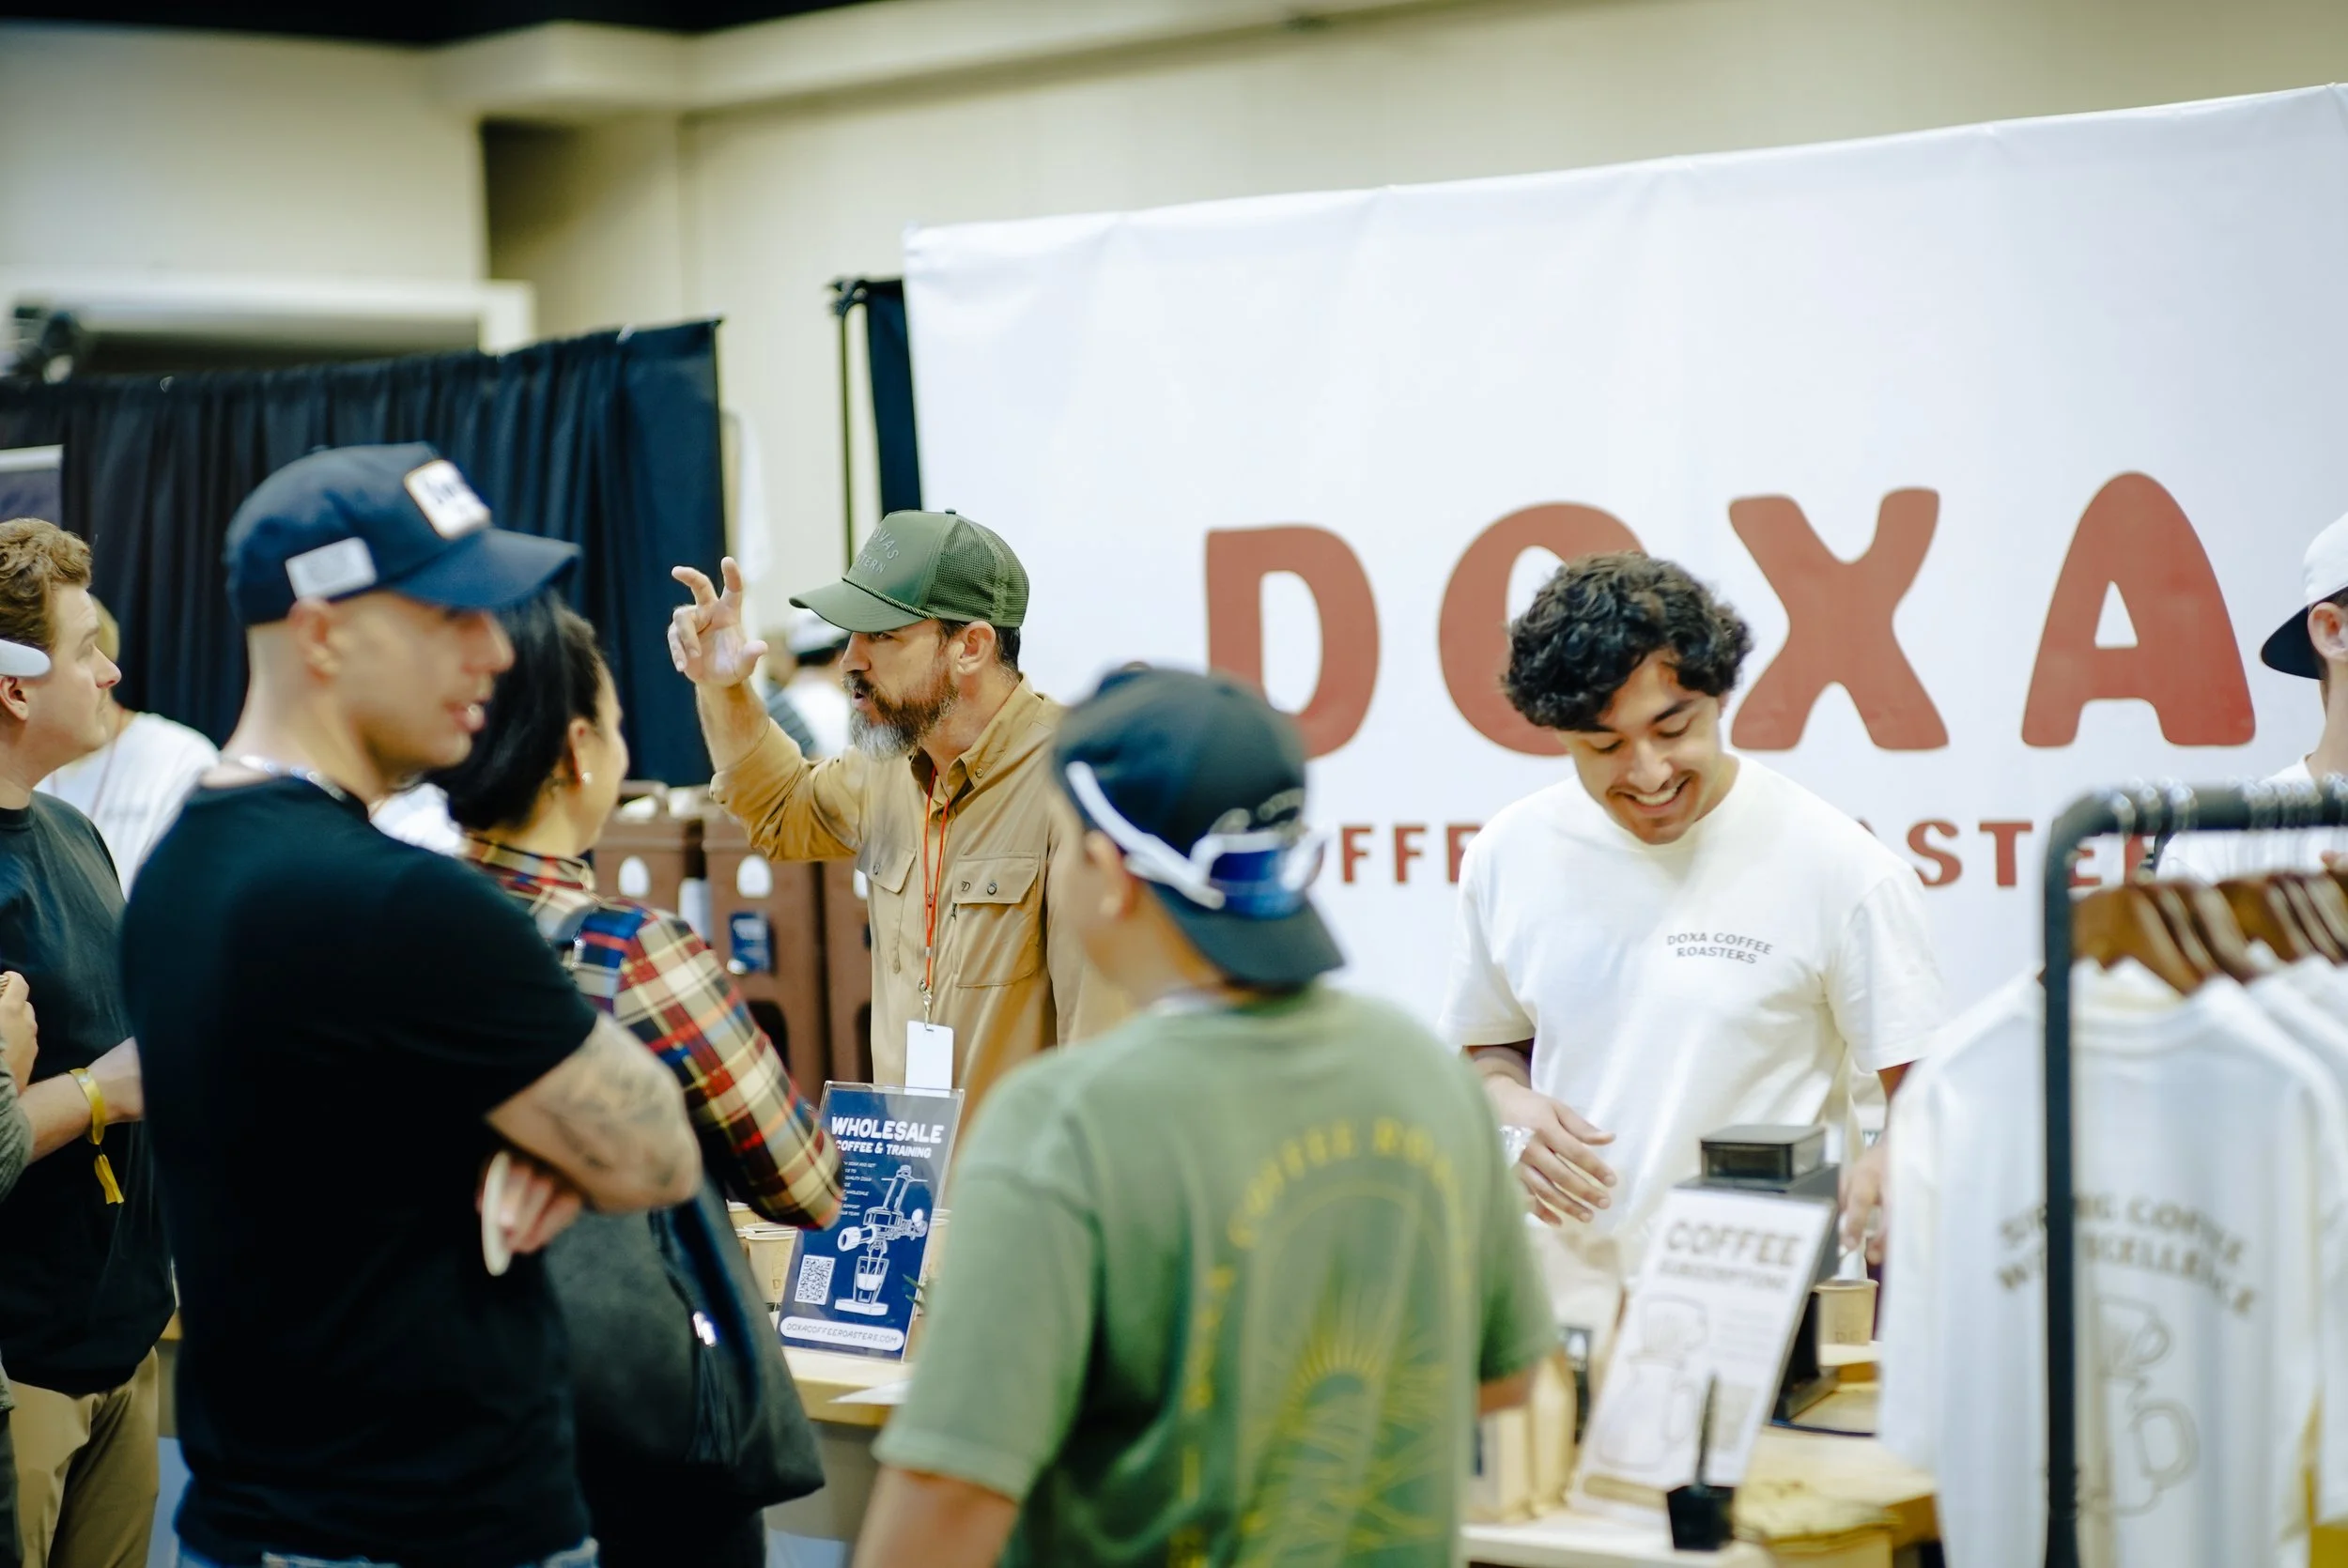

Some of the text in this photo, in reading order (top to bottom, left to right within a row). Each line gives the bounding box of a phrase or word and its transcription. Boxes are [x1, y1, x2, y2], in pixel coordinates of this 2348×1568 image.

[873, 526, 899, 560] OVAS
[1205, 471, 2256, 761] DOXA
[1667, 932, 1773, 956] DOXA COFFEE
[1676, 946, 1757, 964] ROASTERS
[831, 1116, 945, 1145] WHOLESALE
[835, 1140, 933, 1159] COFFEE & TRAINING
[1666, 1221, 1802, 1268] COFFEE
